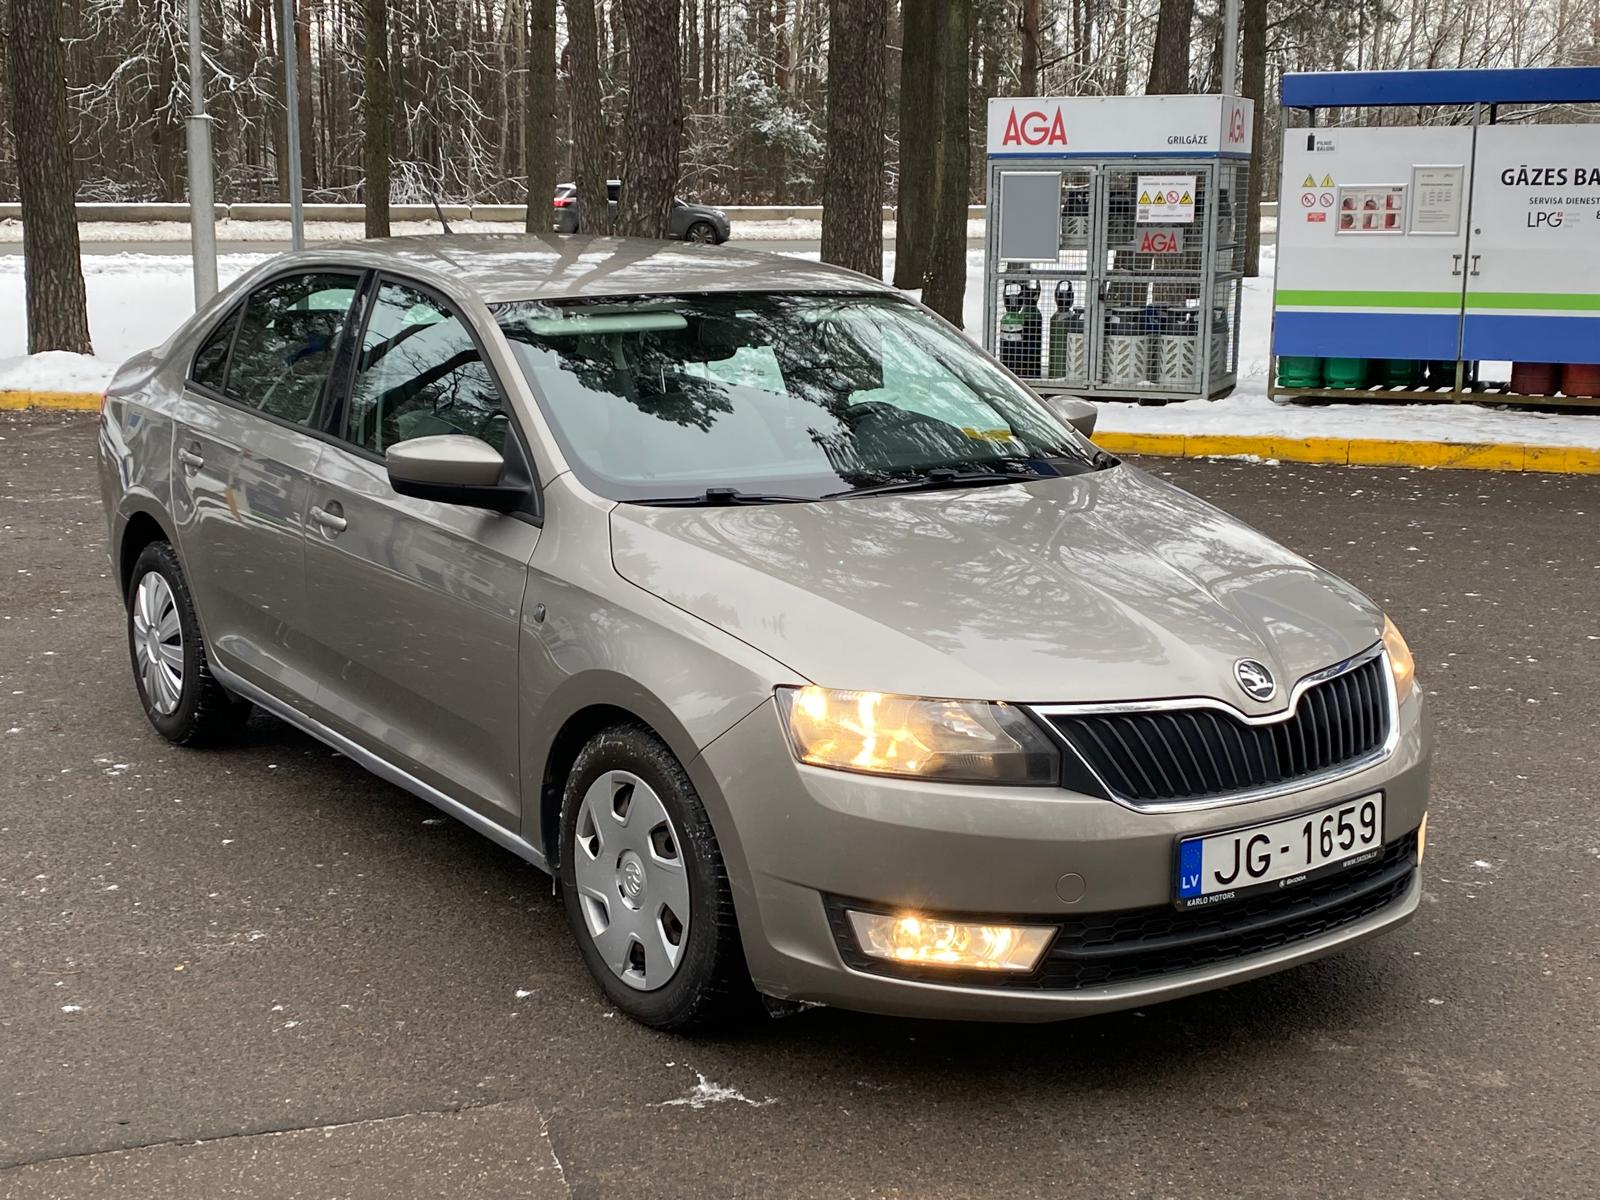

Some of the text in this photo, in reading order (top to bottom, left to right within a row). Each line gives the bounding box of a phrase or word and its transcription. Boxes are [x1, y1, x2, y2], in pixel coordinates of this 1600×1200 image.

[1002, 105, 1068, 146] AGA
[1228, 104, 1245, 144] AGA
[1501, 165, 1600, 186] GĀZES BA
[1529, 196, 1563, 205] SERVISA
[1527, 211, 1563, 228] LPG
[1140, 231, 1178, 252] AGA
[1182, 874, 1200, 889] LV
[1187, 891, 1235, 907] KARLO MOTORS
